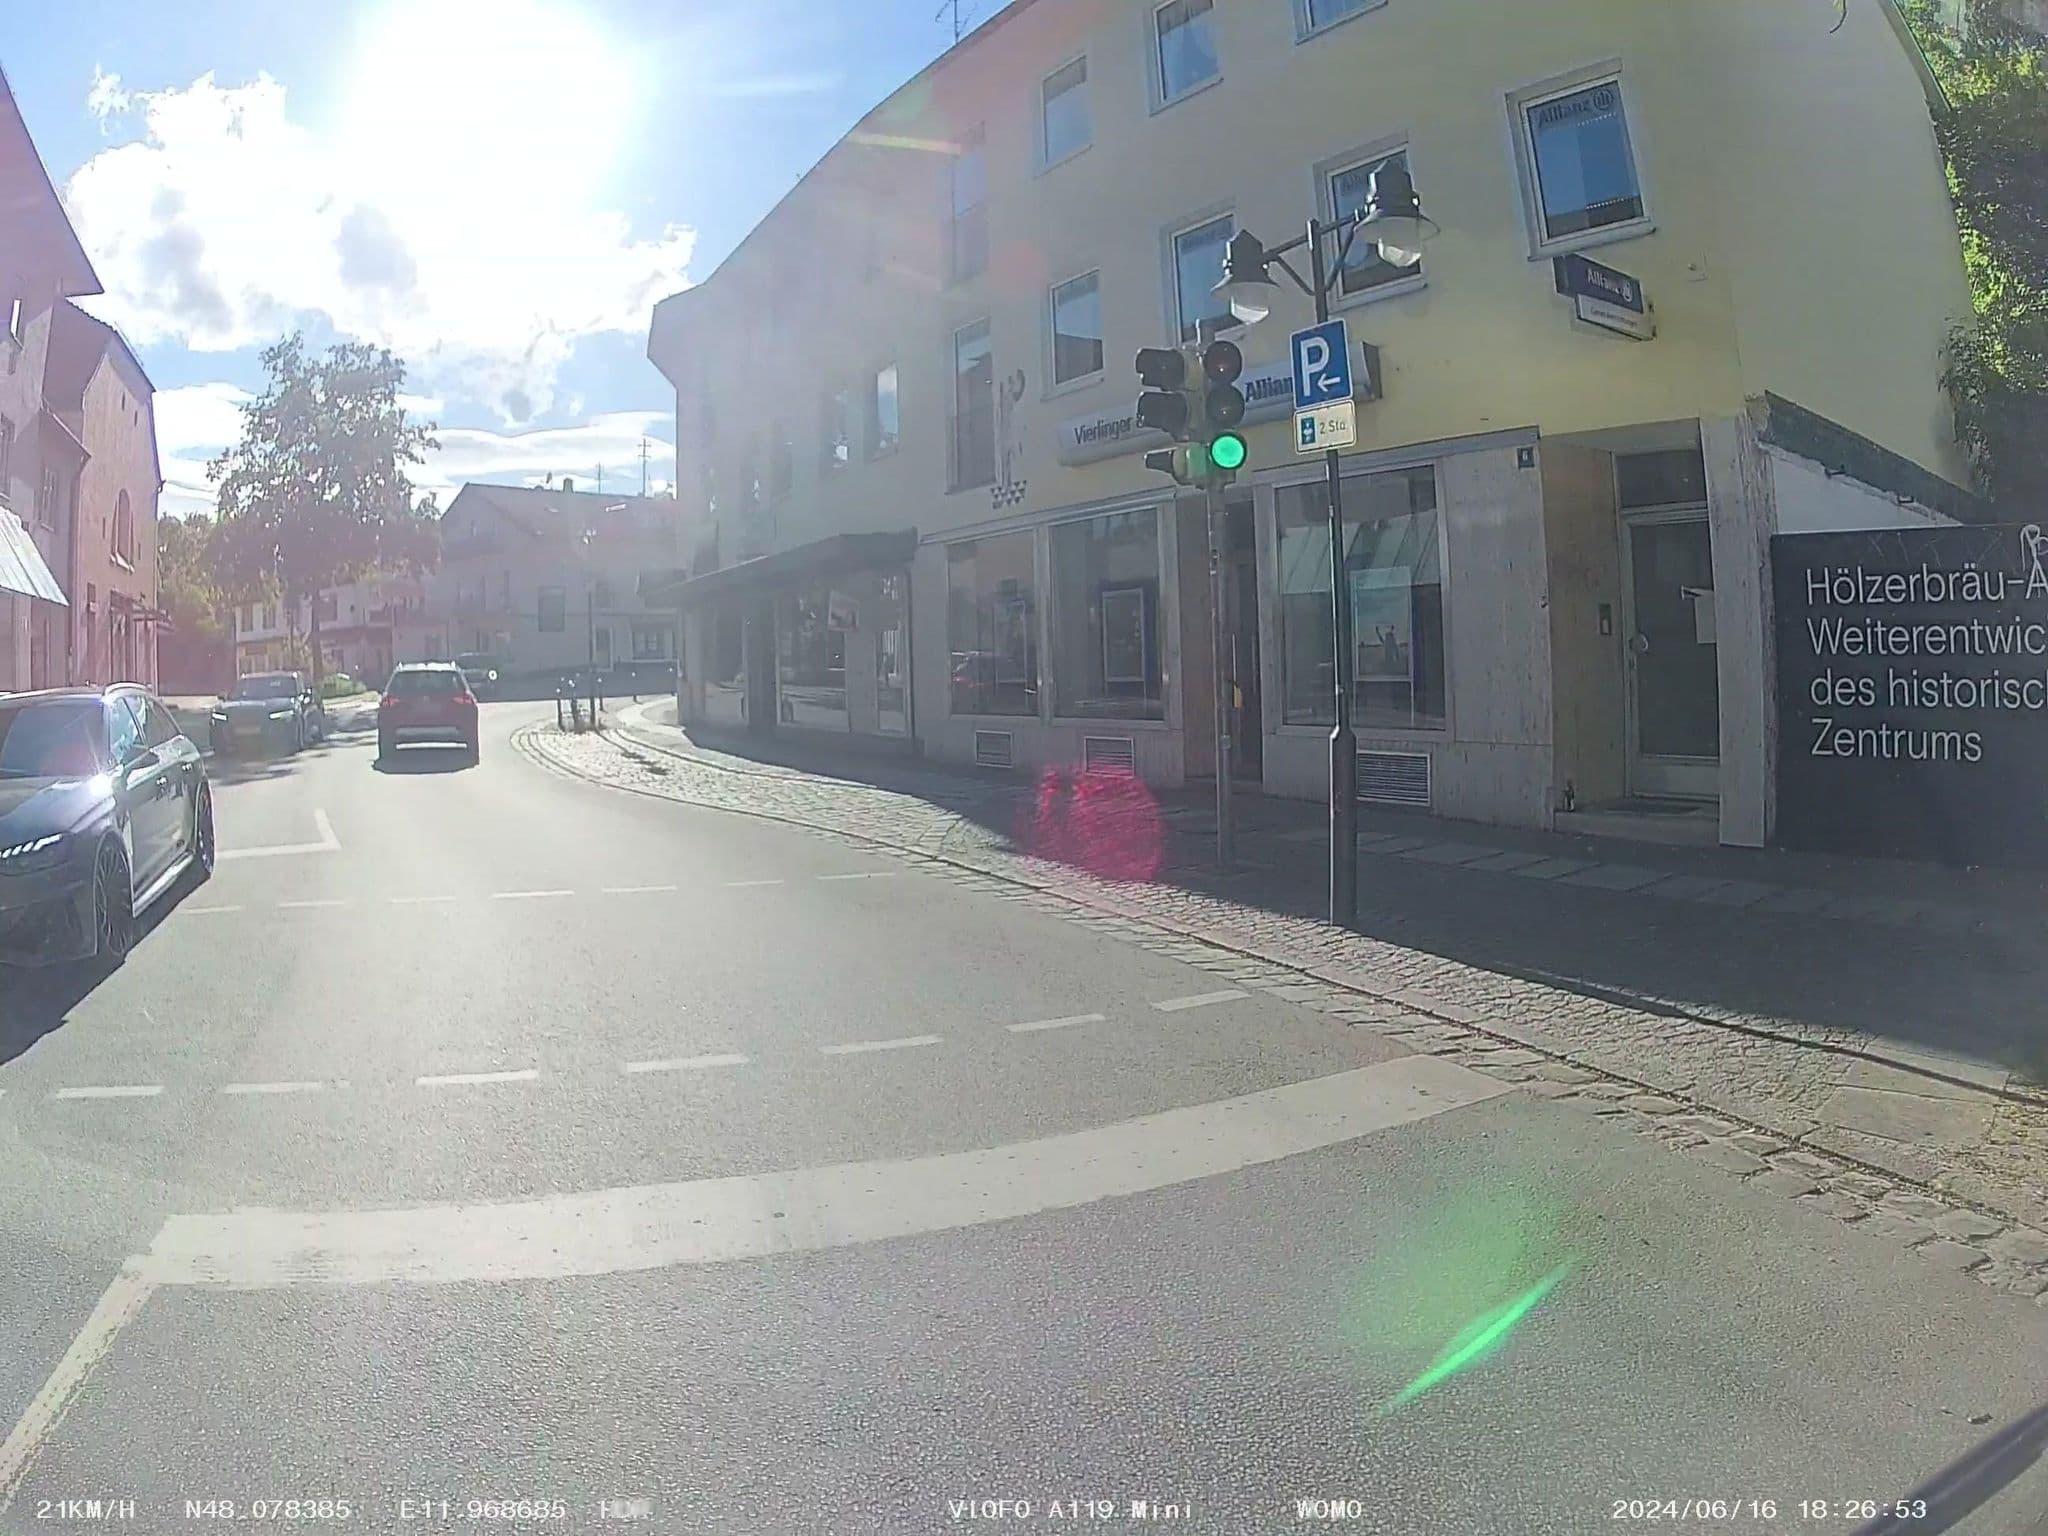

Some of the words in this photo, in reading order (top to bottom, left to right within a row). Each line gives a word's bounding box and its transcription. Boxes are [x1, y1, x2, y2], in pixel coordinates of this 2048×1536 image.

[1300, 336, 1330, 397] P
[1073, 416, 1134, 444] Vierlinger
[1245, 376, 1293, 402] Allian
[1319, 421, 1326, 434] 2
[1806, 562, 2048, 605] Hölzerbräu-A
[1810, 667, 1876, 706] des
[1888, 667, 2048, 709] historisc
[1811, 718, 1983, 762] Zentrums
